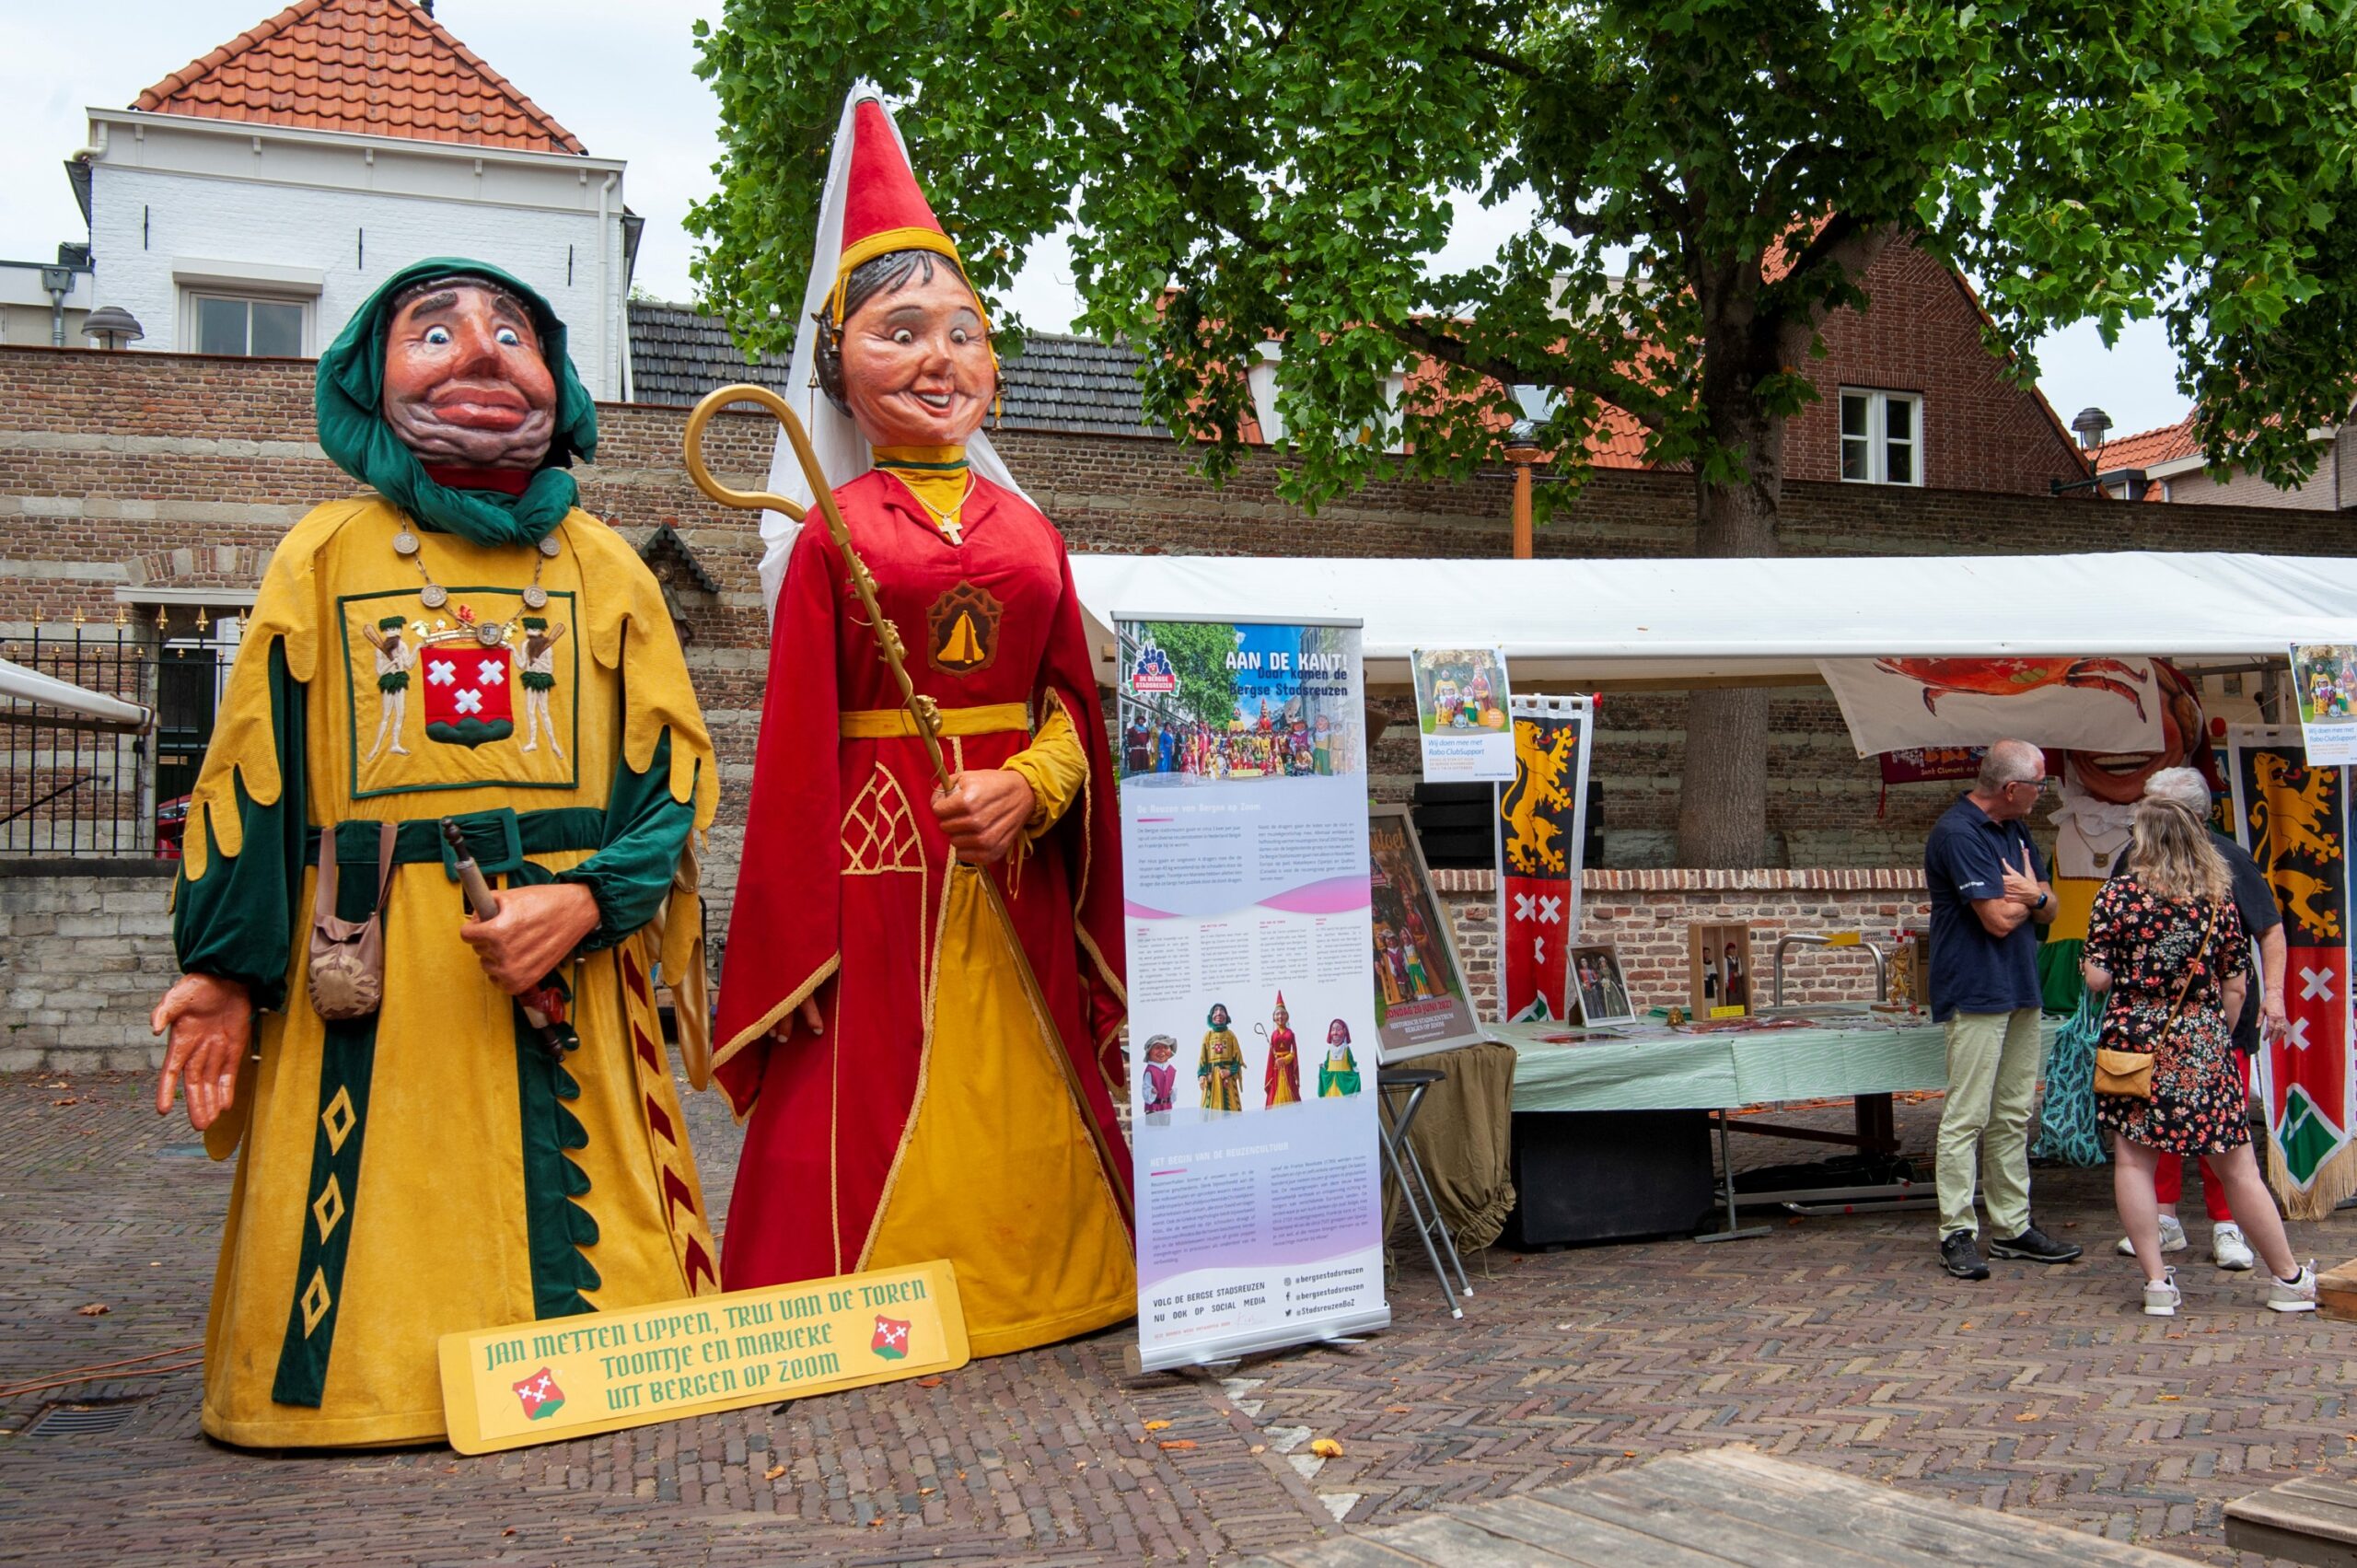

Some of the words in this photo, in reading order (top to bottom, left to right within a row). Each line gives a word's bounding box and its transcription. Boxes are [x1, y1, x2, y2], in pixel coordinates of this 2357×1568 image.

[1225, 651, 1261, 669] AAN
[1270, 652, 1290, 670] DE
[1298, 653, 1348, 671] KANT!
[1258, 666, 1284, 679] Daar
[1290, 666, 1329, 679] komen
[1334, 668, 1347, 679] de
[1229, 682, 1271, 699] Bergse
[1275, 682, 1348, 696] Stadsreuzen
[1428, 739, 1439, 748] Wij
[1446, 748, 1485, 757] ClubSupport
[1385, 1005, 1413, 1019] ZONDAG
[1150, 1156, 1166, 1167] HET
[1167, 1154, 1193, 1166] BEGIN
[1195, 1152, 1211, 1162] VAN
[1213, 1149, 1223, 1159] DE
[1153, 1296, 1172, 1308] VOLG
[1175, 1295, 1184, 1305] DE
[1187, 1290, 1214, 1302] BERGSE
[1216, 1281, 1266, 1297] STADSREUZEN
[1154, 1314, 1166, 1323] NU
[1172, 1309, 1188, 1320] OOK
[1194, 1307, 1204, 1316] OP
[1212, 1301, 1237, 1313] SOCIAL
[1243, 1295, 1266, 1307] MEDIA
[484, 1339, 528, 1371] JAN
[532, 1324, 627, 1359] METTEN
[633, 1311, 720, 1343] LIPPEN,
[723, 1301, 773, 1329] TRUI
[779, 1294, 822, 1320] VAN
[828, 1289, 855, 1313] DE
[858, 1278, 927, 1309] TOREN
[600, 1344, 694, 1381] TOONTJE
[701, 1339, 731, 1365] EN
[732, 1322, 834, 1360] MARIEKE
[605, 1383, 644, 1411] UIT
[649, 1365, 738, 1404] BERGEN
[743, 1361, 772, 1388] OP
[777, 1351, 841, 1383] ZOOM
